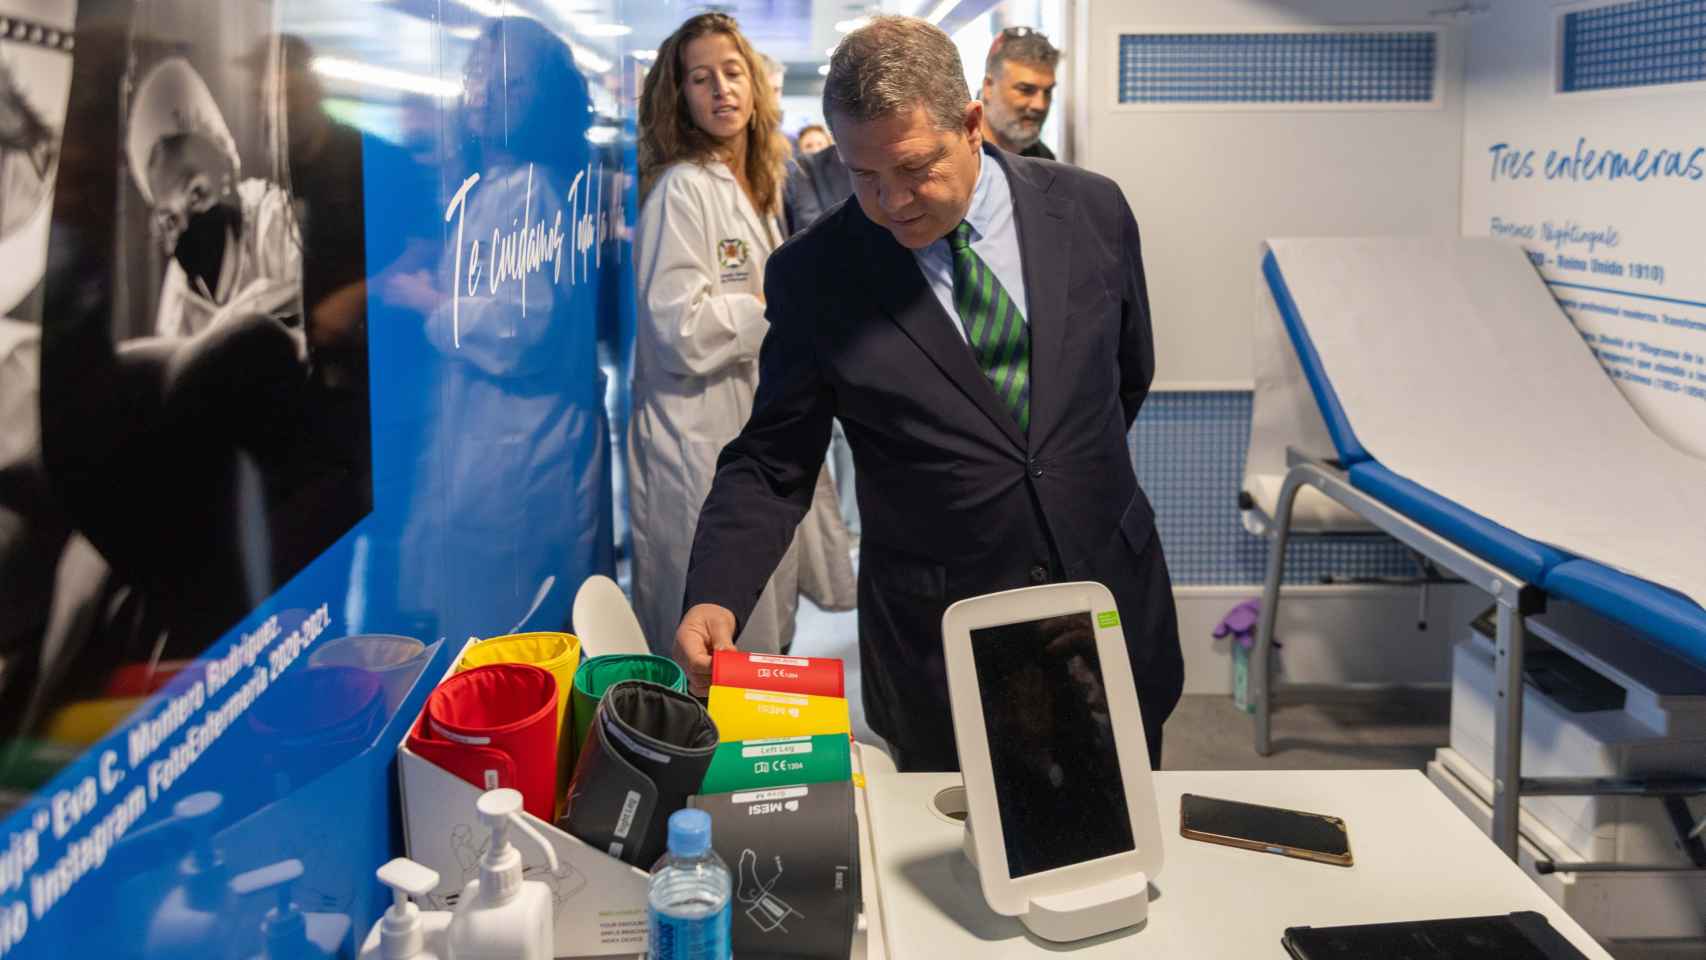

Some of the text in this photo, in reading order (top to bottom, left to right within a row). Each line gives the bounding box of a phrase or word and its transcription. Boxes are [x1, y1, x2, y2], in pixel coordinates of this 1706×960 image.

[1489, 137, 1706, 182] Tres enfermeras
[445, 172, 482, 349] Te
[490, 162, 564, 319] cuidamos
[52, 777, 97, 840] Eva
[128, 681, 204, 769] Montero
[749, 802, 782, 816] MESI
[30, 785, 147, 920] Instagram
